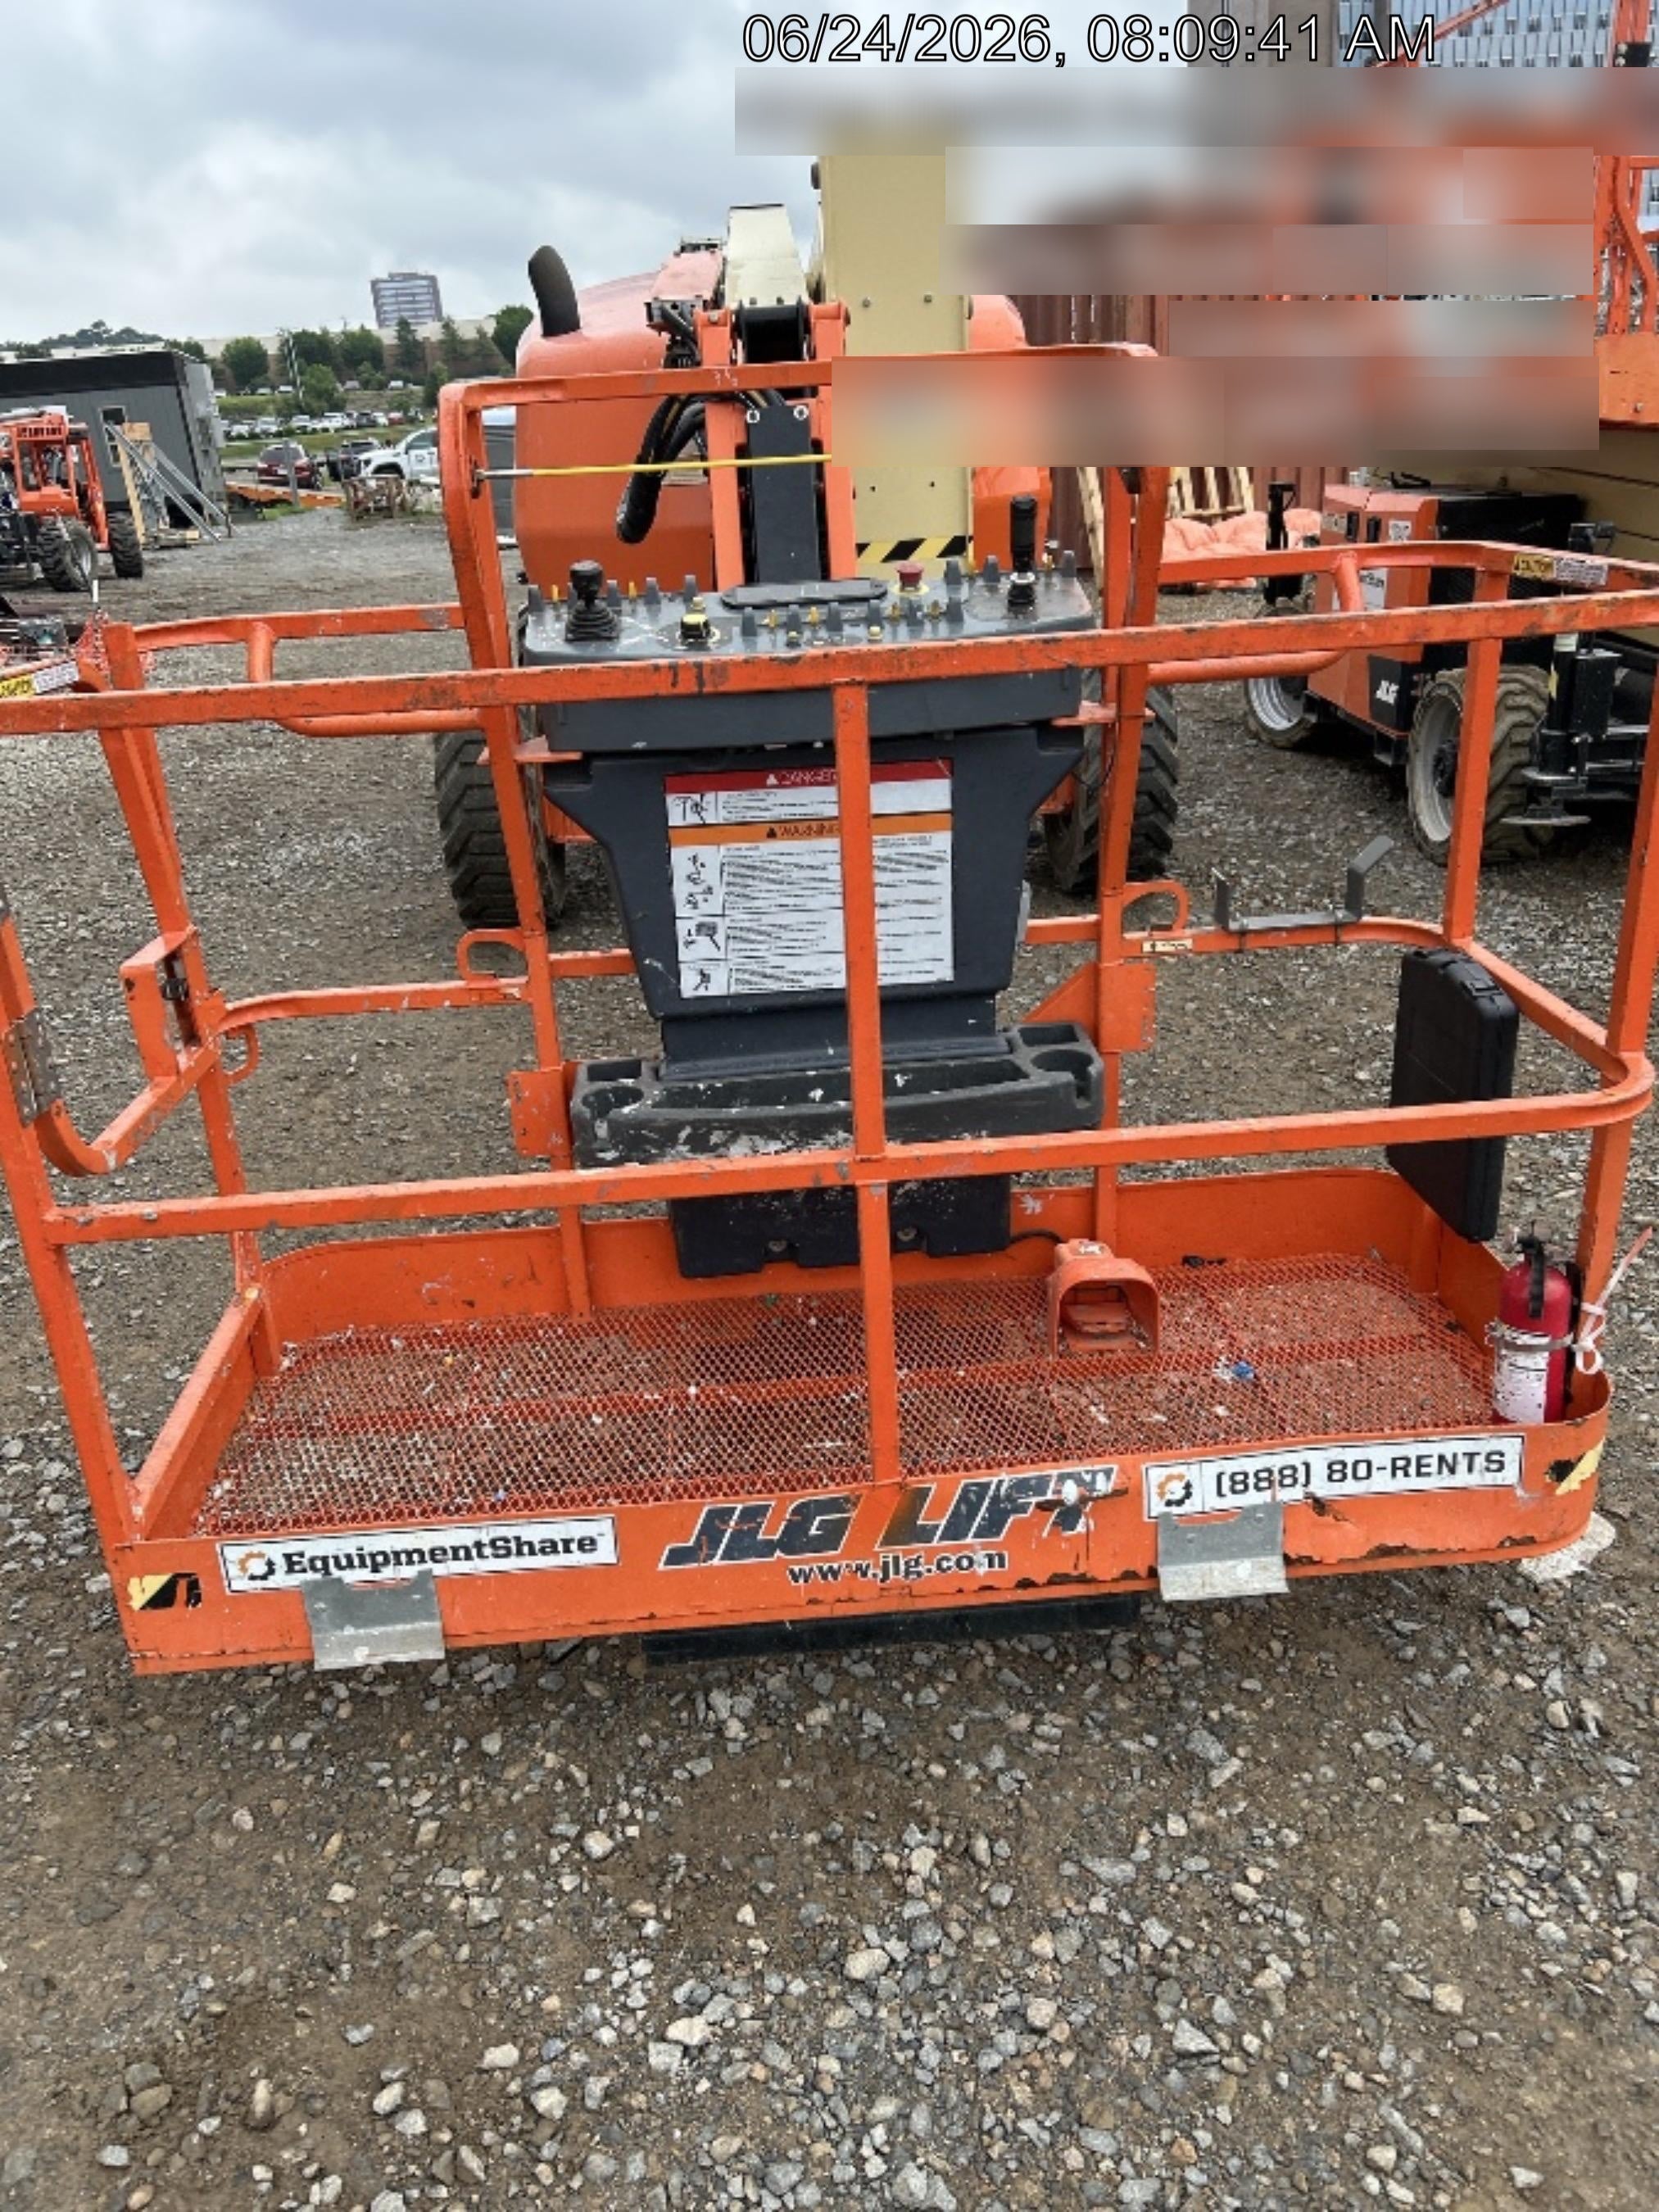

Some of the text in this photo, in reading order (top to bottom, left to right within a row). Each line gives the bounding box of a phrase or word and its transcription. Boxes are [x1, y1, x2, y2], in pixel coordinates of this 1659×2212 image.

[1216, 1450, 1507, 1498] (888) 80-RENTS
[658, 1465, 1118, 1570] JLG LIFT
[282, 1534, 598, 1576] EquipmentShare
[786, 1549, 1009, 1585] www.jlg.com
